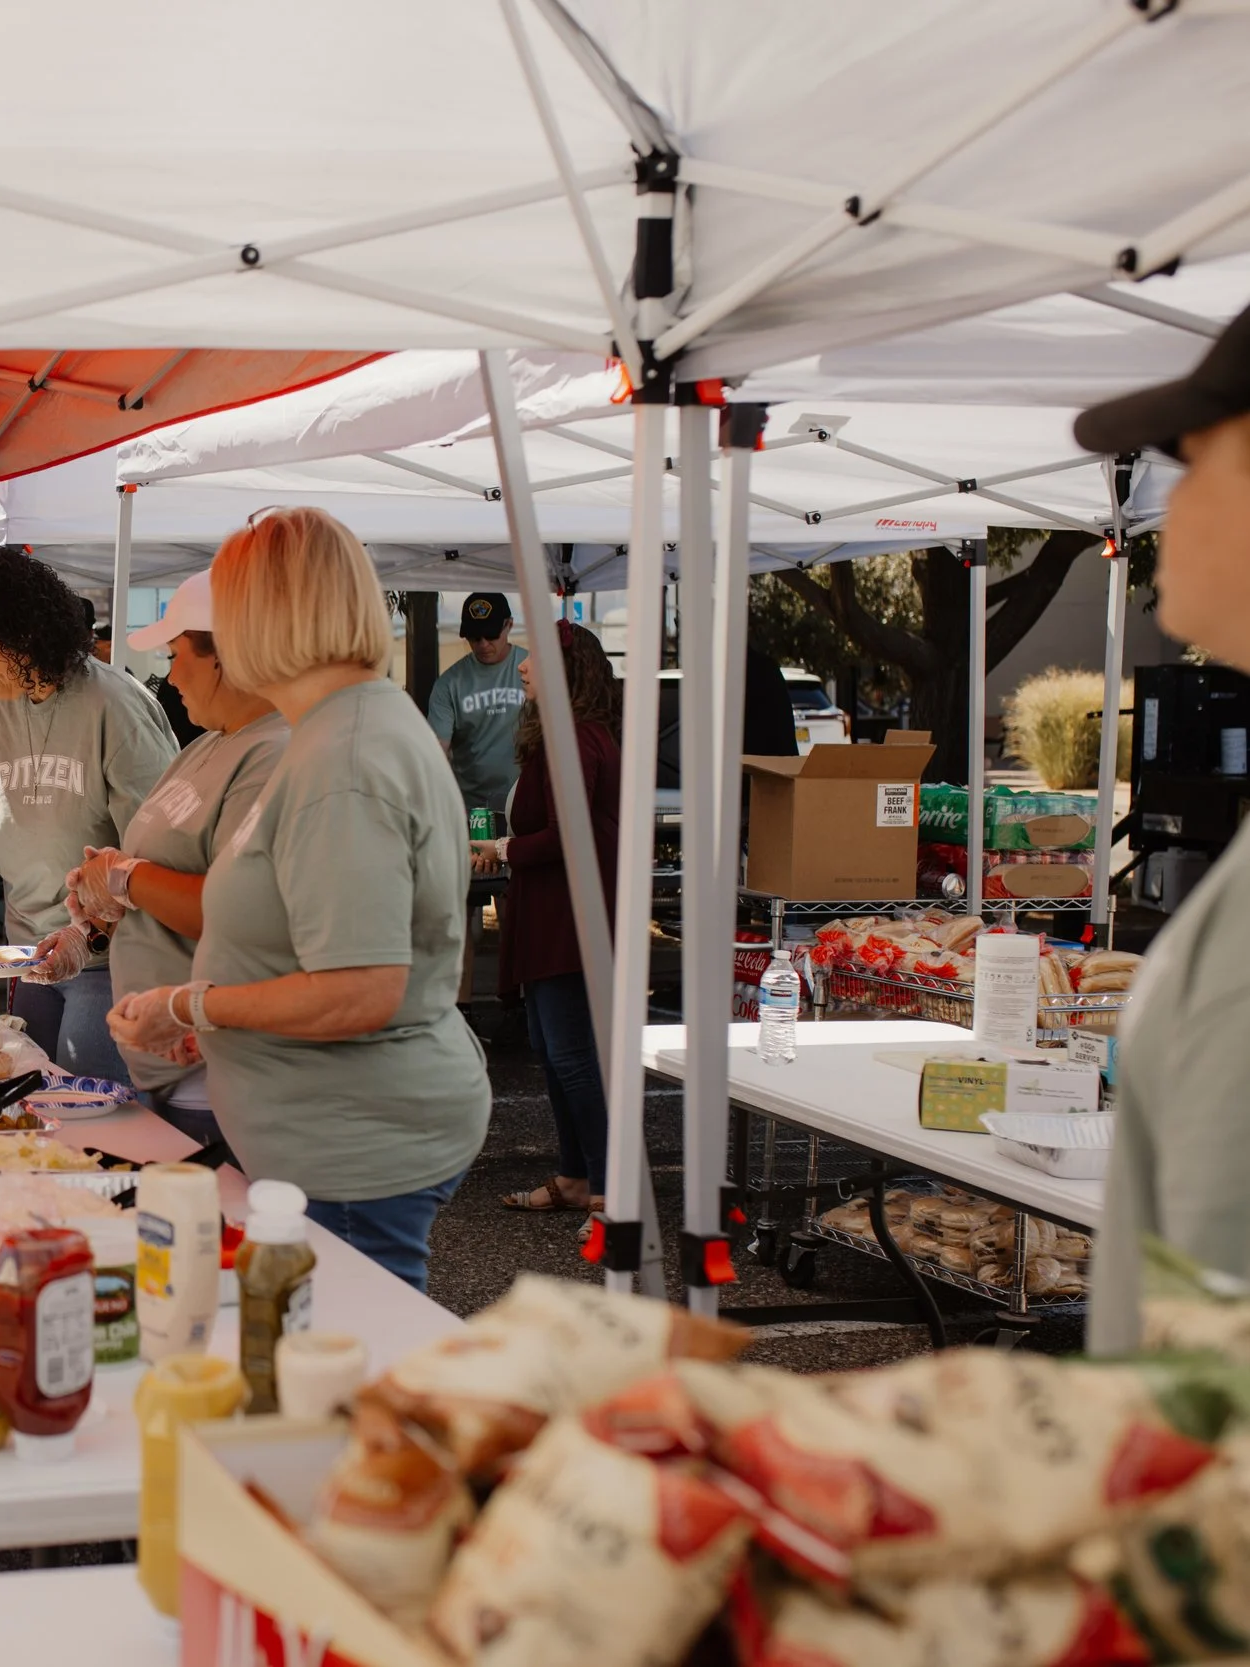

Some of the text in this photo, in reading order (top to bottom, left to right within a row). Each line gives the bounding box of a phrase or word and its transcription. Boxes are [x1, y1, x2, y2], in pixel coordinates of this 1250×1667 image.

[887, 797, 904, 805] BEEF
[884, 806, 907, 814] FRANK
[958, 1076, 985, 1086] VINYL
